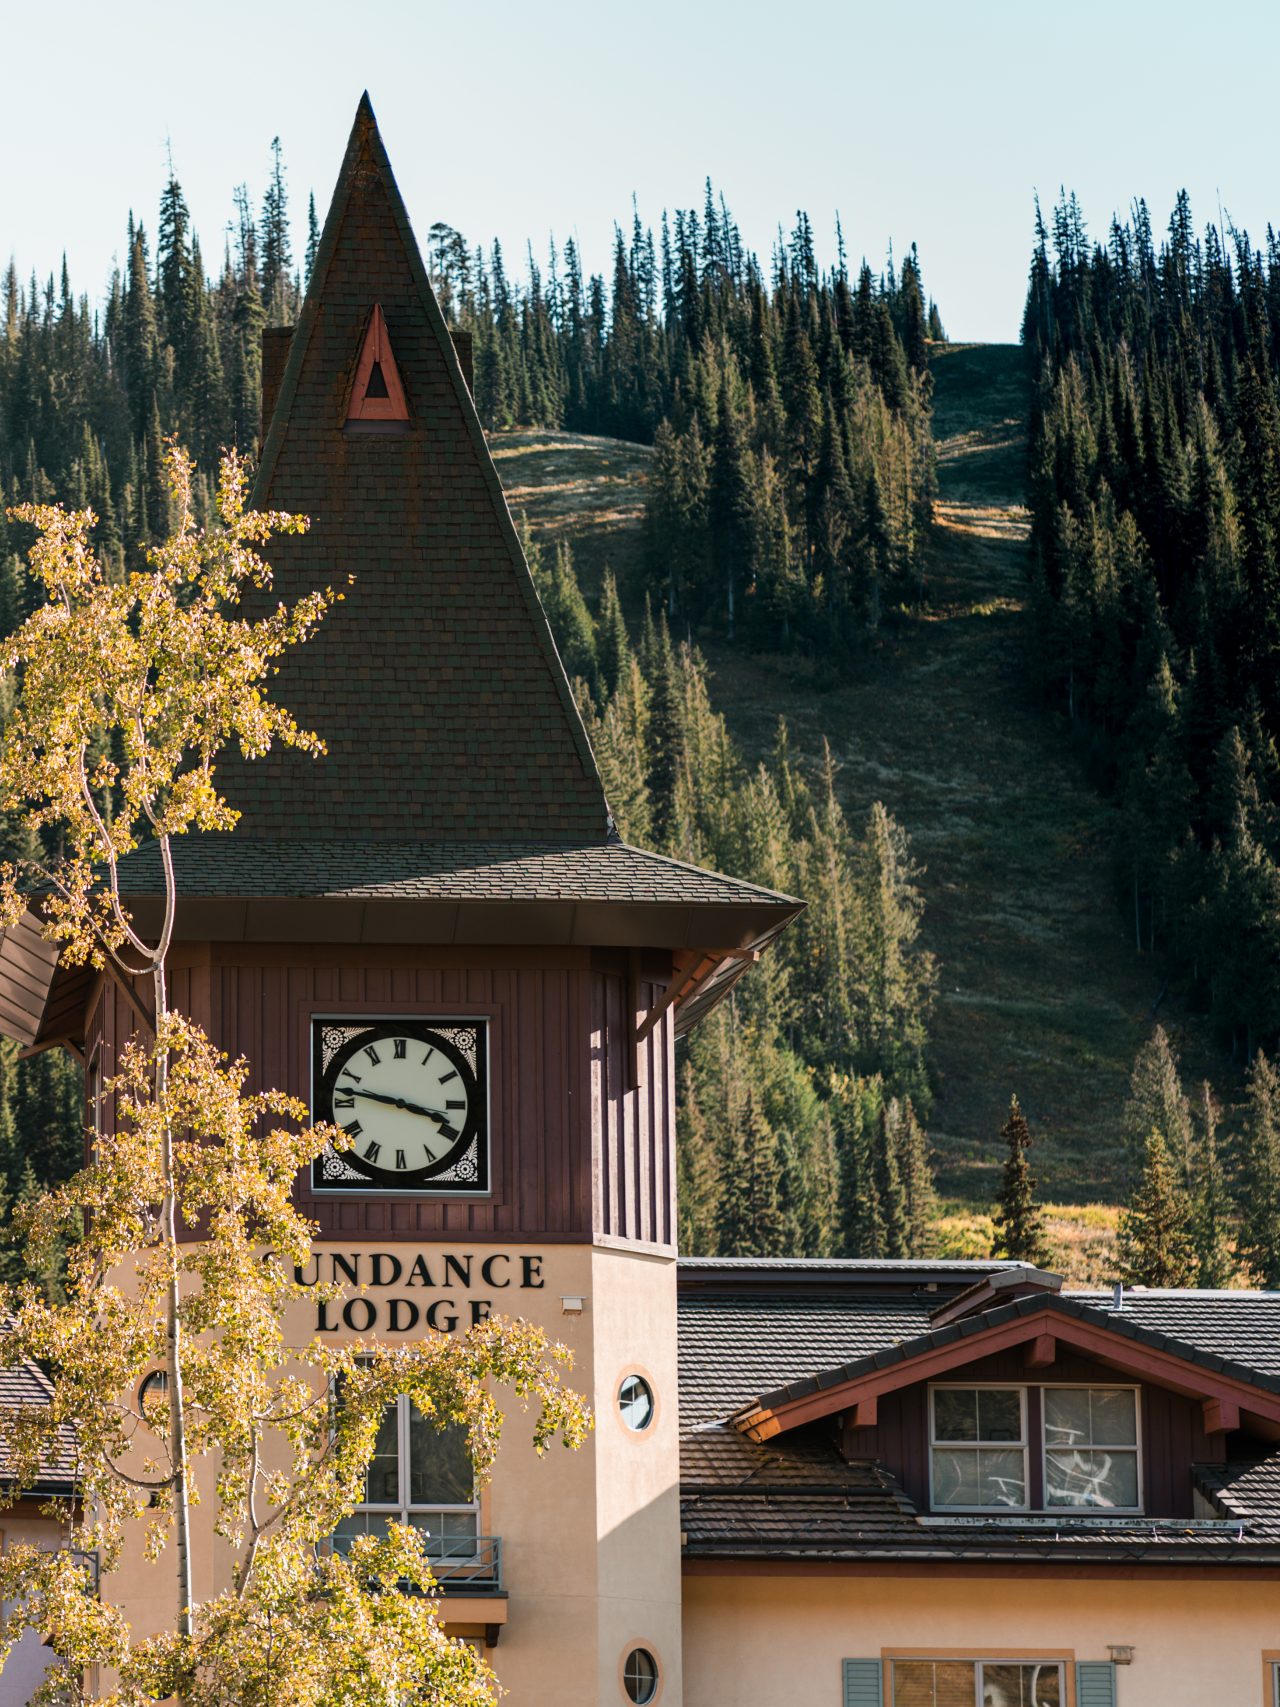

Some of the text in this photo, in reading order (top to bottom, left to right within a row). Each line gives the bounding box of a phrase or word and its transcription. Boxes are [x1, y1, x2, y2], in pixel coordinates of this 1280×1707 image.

[363, 1045, 381, 1067] XI
[393, 1039, 407, 1060] XII
[421, 1048, 435, 1066] I
[342, 1067, 362, 1084] X
[438, 1070, 459, 1085] II
[334, 1097, 355, 1109] IX
[446, 1100, 466, 1110] III
[363, 1140, 382, 1164] VII
[395, 1149, 407, 1170] VI
[423, 1144, 438, 1163] V
[262, 1251, 545, 1289] UNDANCE
[314, 1298, 492, 1333] LODGE
